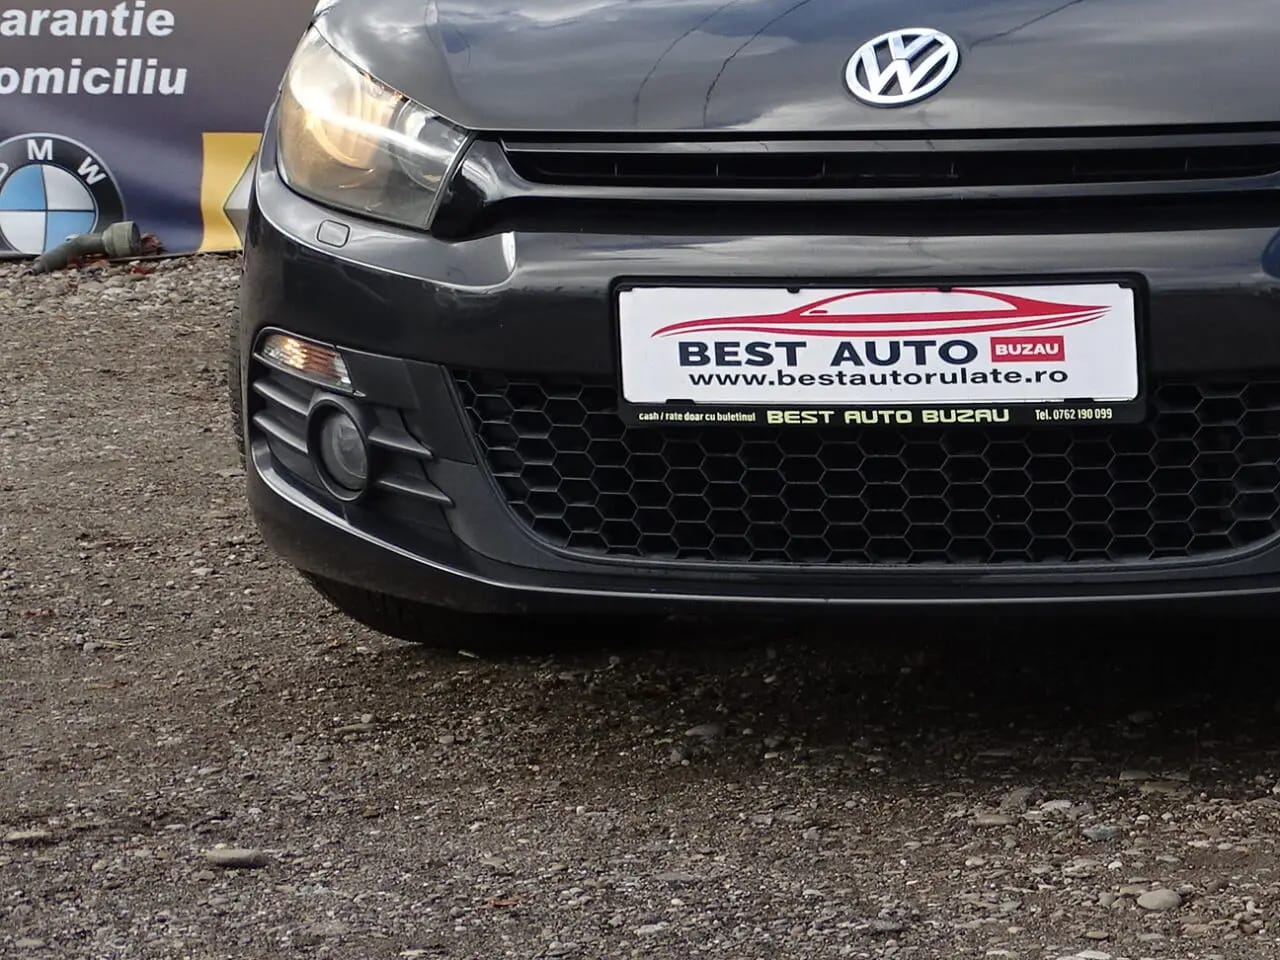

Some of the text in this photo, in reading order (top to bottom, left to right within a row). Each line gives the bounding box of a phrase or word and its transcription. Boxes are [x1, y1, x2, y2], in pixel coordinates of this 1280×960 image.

[1, 1, 175, 37] arantie
[0, 58, 188, 96] omiciliu
[678, 339, 979, 367] BEST AUTO
[995, 343, 1060, 356] BUZAU
[688, 367, 1069, 386] www.bestautorulate.ro
[638, 411, 659, 421] cash
[665, 412, 683, 421] rate
[684, 411, 704, 421] doar
[705, 413, 716, 421] cu
[717, 412, 756, 422] buletinul
[766, 408, 1010, 424] BEST AUTO BUZAU
[1035, 408, 1113, 421] Tel. 0762 190 099
